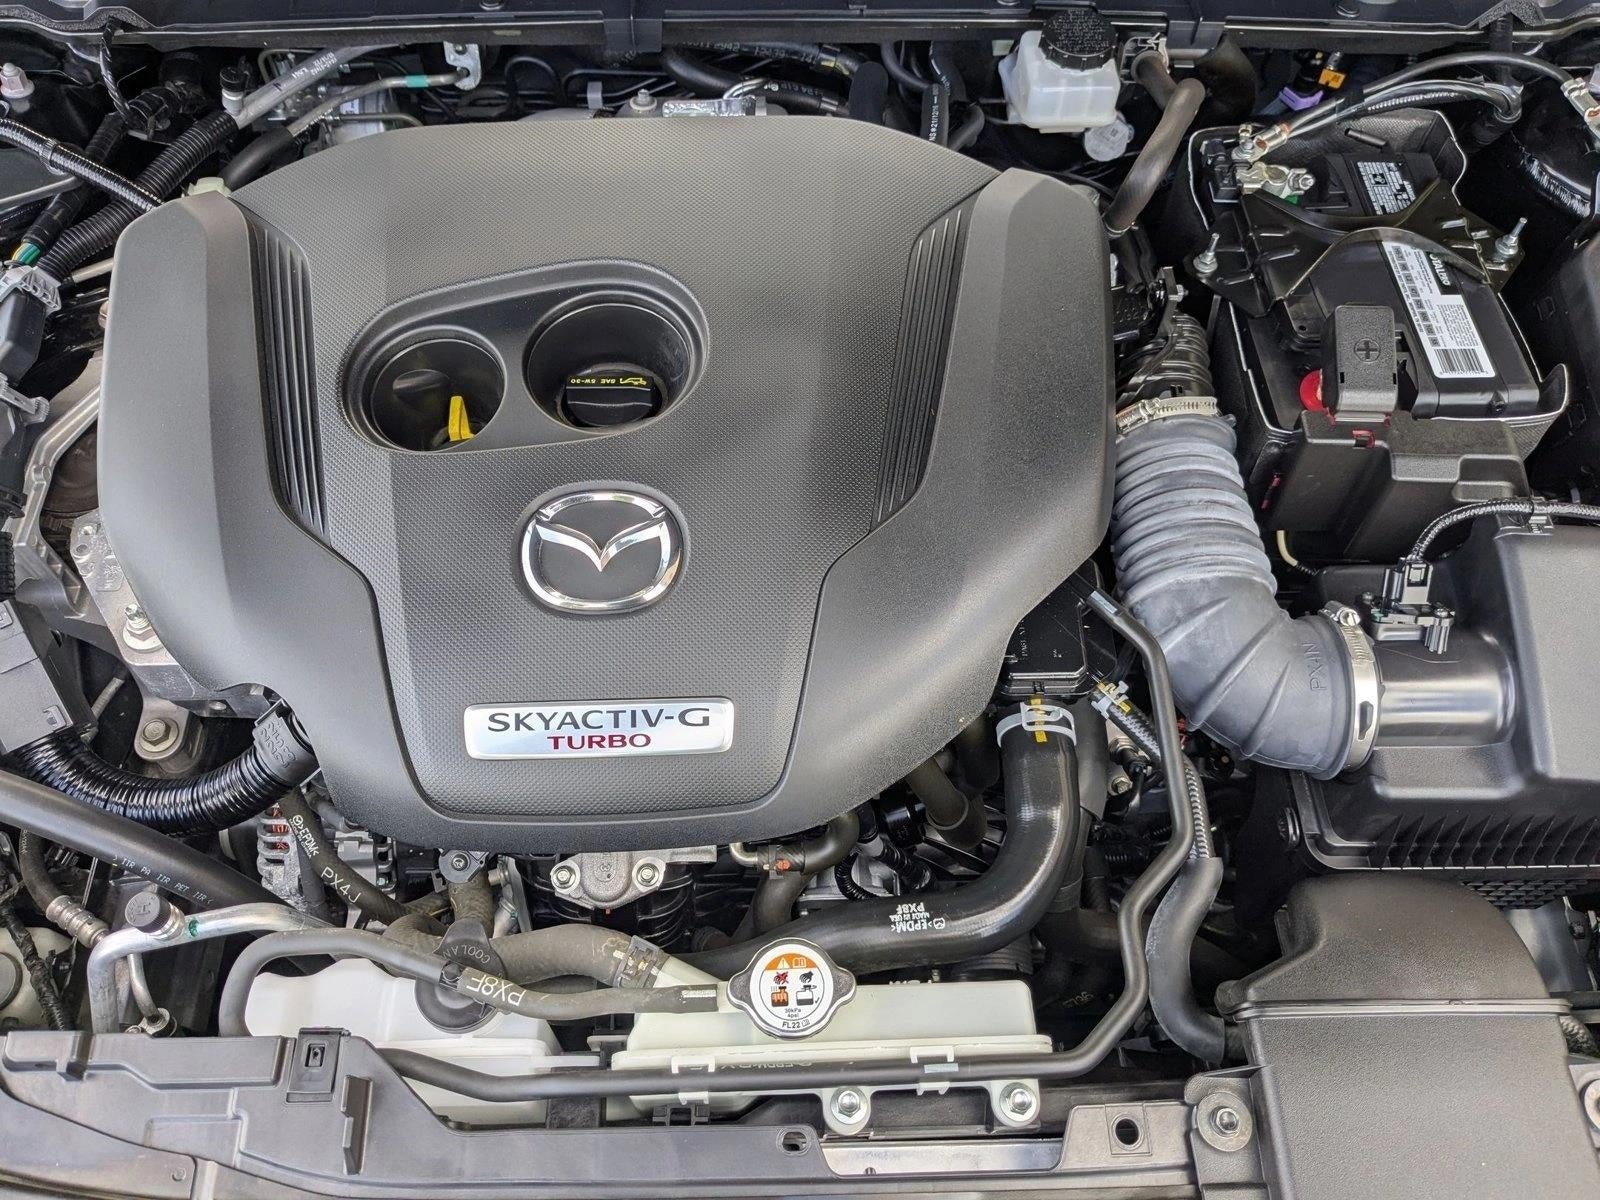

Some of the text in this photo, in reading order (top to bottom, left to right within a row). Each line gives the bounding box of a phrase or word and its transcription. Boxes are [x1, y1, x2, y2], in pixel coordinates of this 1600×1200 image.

[488, 708, 710, 732] SKYACTIV-G
[547, 733, 652, 750] TURBO
[320, 866, 361, 903] PX4J
[443, 945, 490, 963] COOLAN
[466, 974, 526, 1006] PX8F
[782, 1021, 801, 1029] FL22
